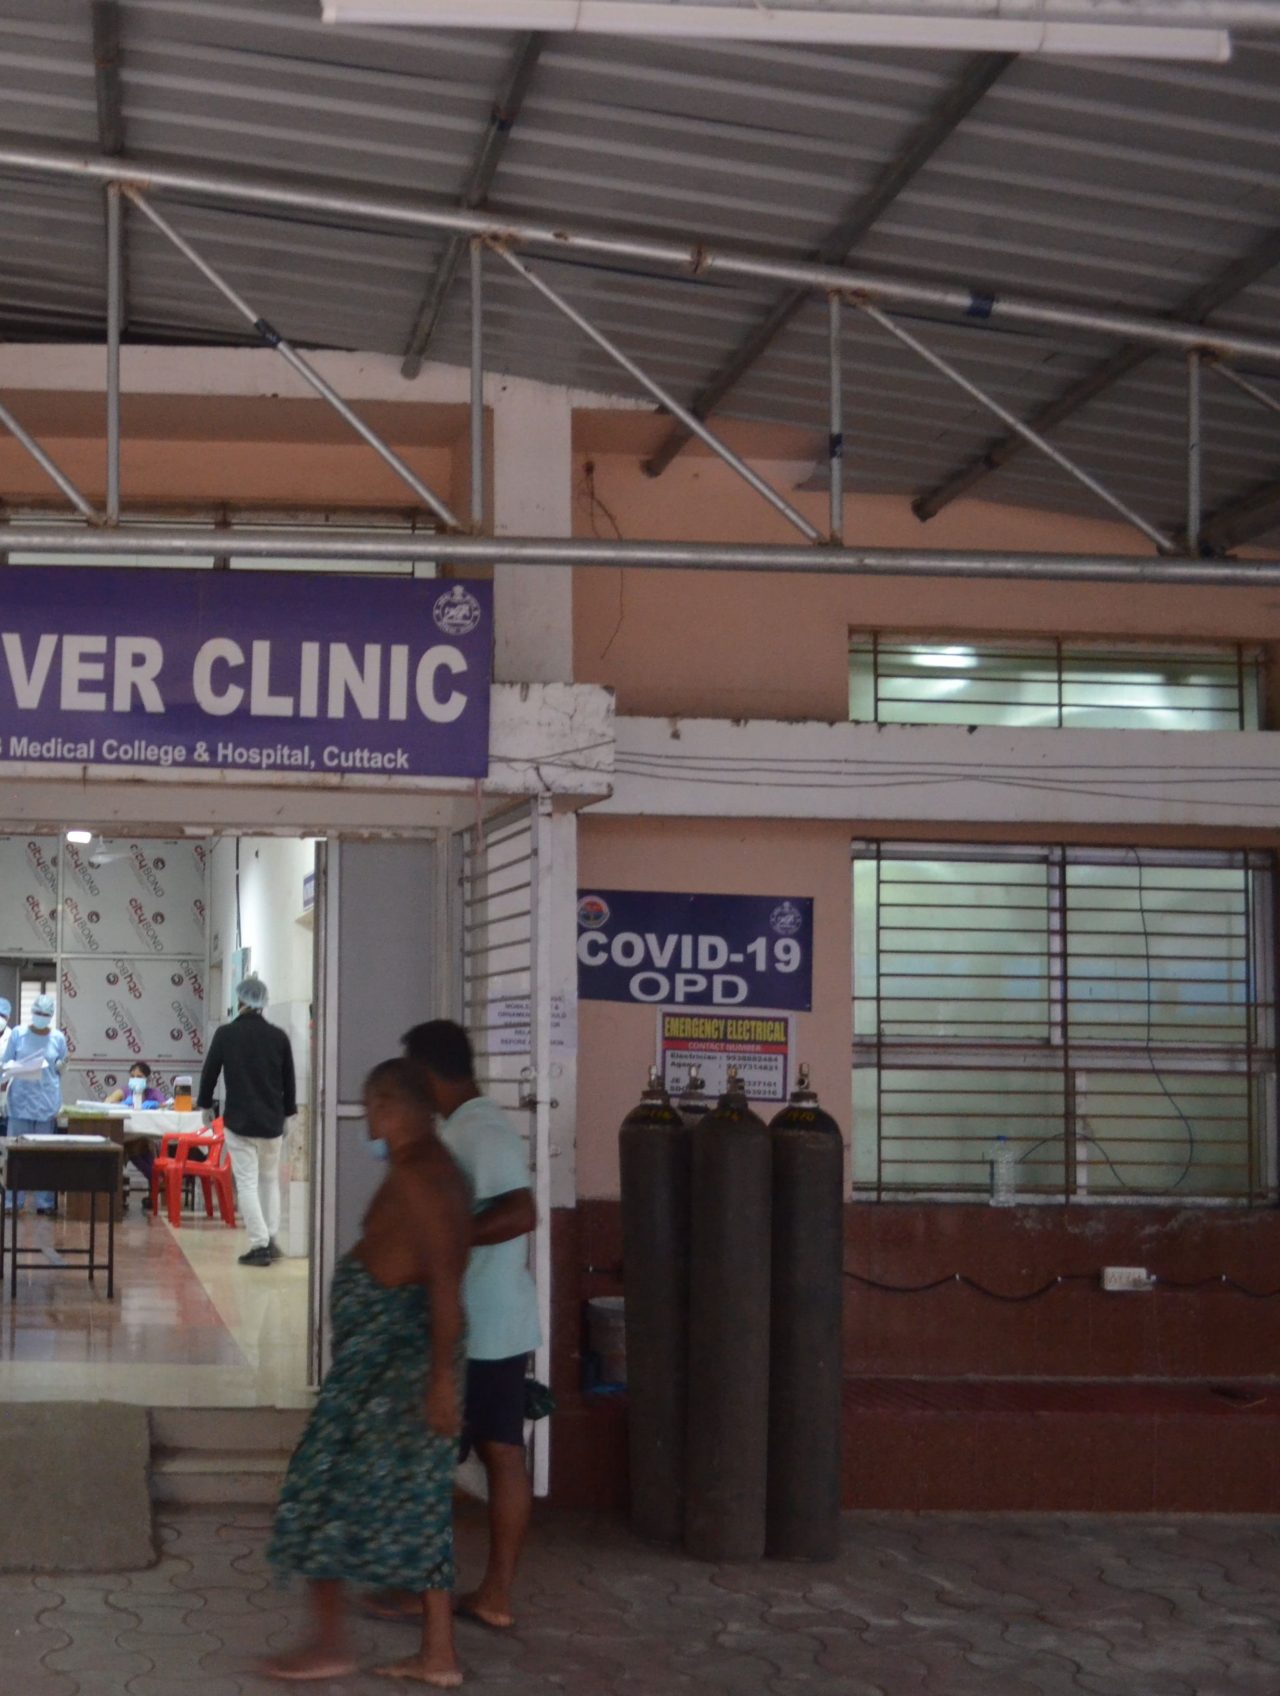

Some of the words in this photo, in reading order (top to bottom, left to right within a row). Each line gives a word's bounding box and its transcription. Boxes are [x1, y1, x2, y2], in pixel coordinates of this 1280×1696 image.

[192, 637, 470, 724] CLINIC
[9, 734, 95, 760] Medical
[102, 739, 187, 767] College
[194, 742, 209, 763] &
[217, 742, 317, 770] Hospital,
[322, 745, 410, 770] Cuttack
[577, 931, 801, 973] COVID-19
[629, 971, 749, 1005] OPD
[665, 1016, 725, 1040] EMERGENCY
[727, 1018, 786, 1043] ELECTRICAL
[670, 1052, 717, 1061] Electrician
[688, 1042, 723, 1050] CONTACT
[726, 1043, 763, 1052] NUMBER
